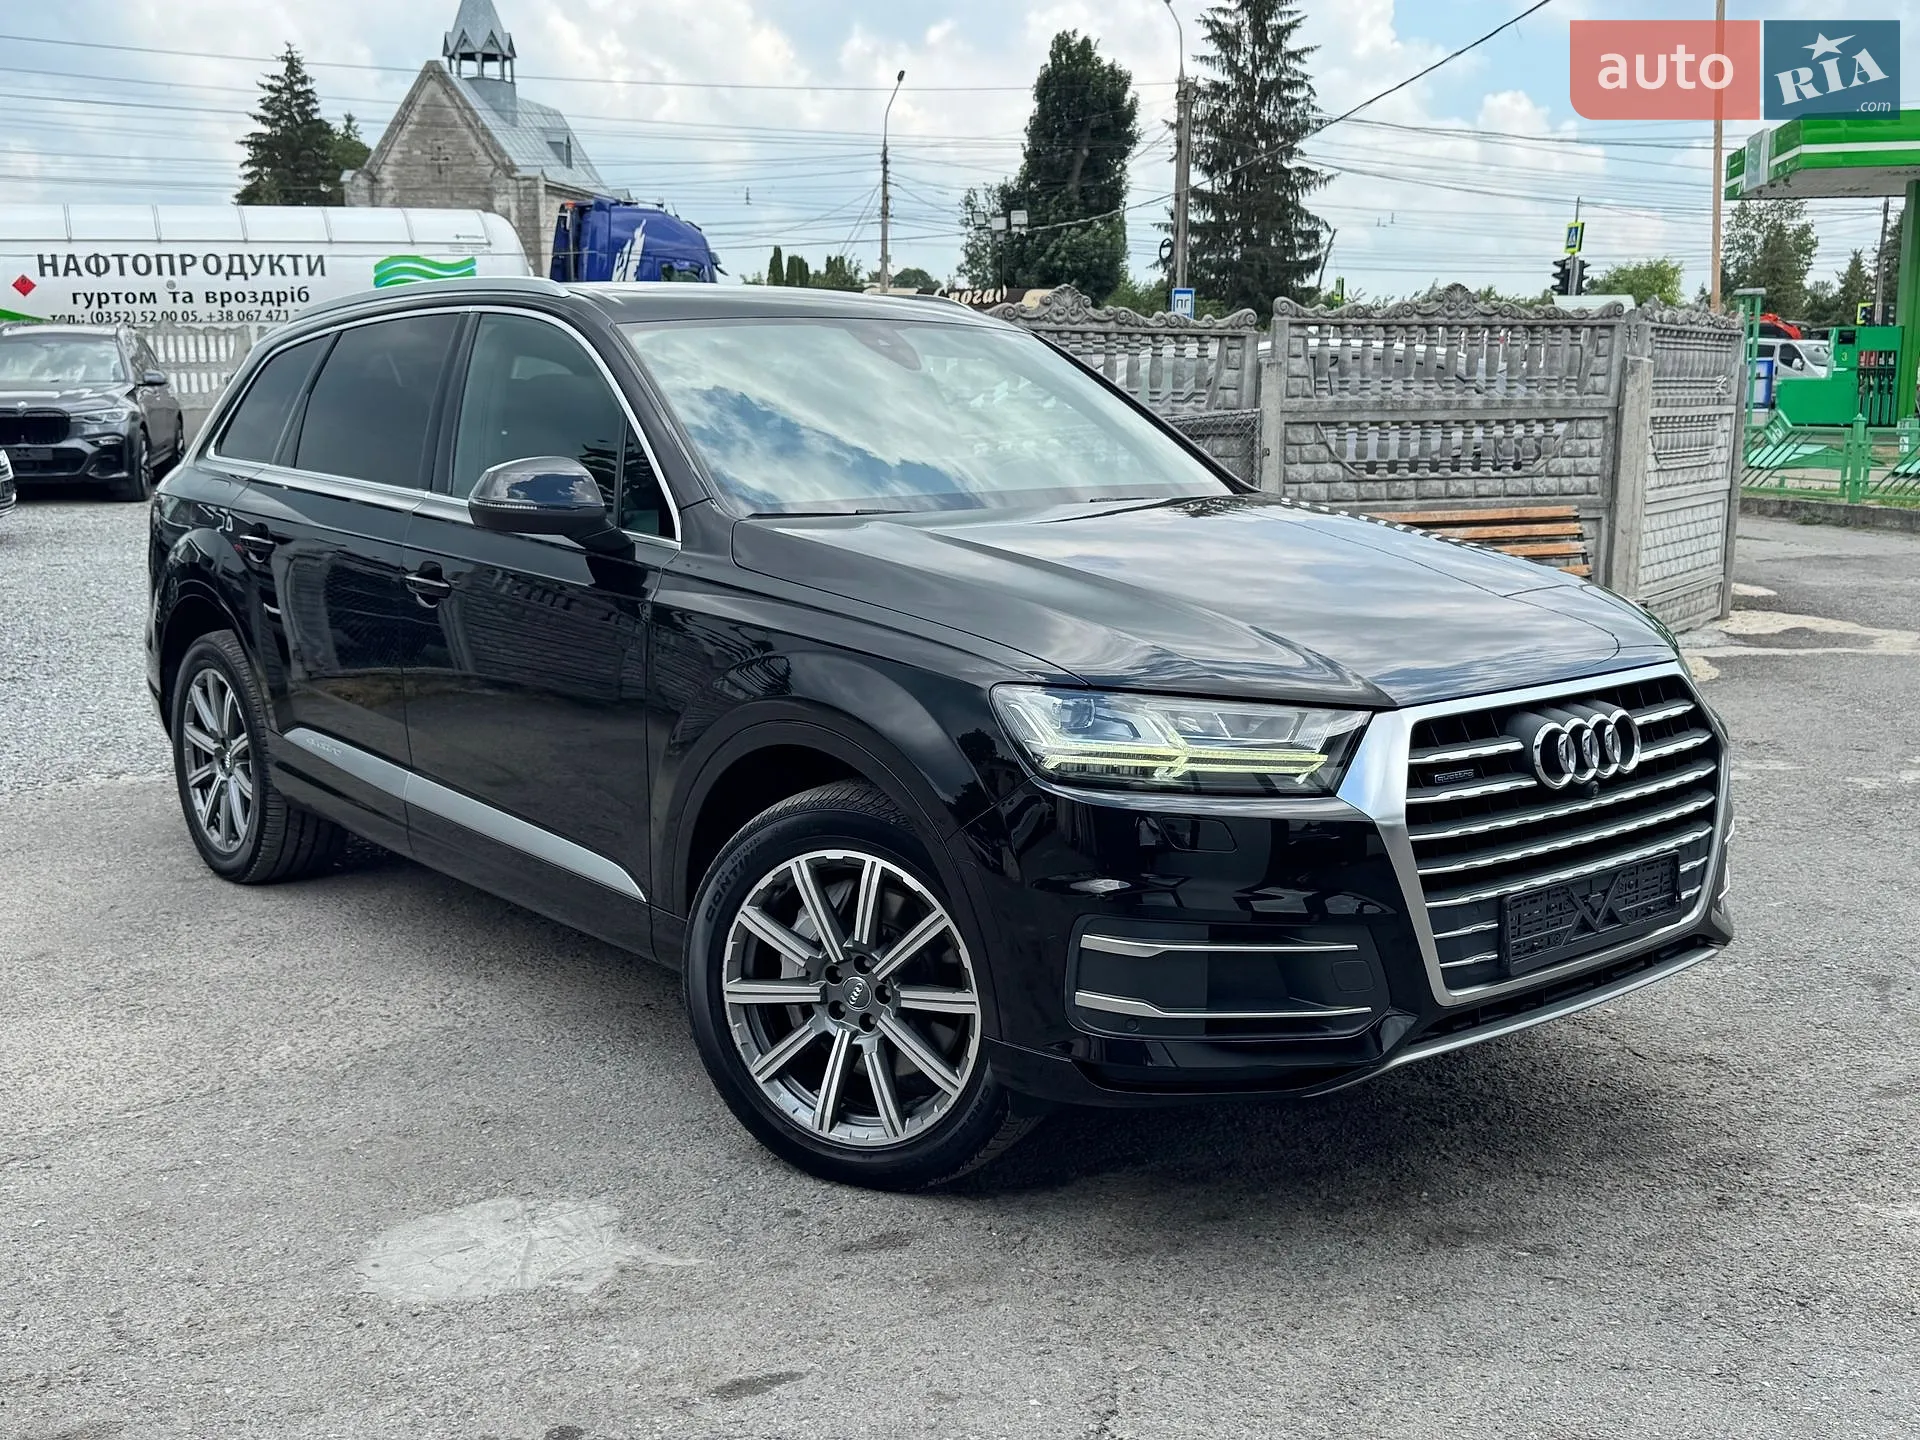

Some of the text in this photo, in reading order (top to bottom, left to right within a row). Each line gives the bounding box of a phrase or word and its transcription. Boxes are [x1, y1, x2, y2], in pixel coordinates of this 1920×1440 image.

[37, 253, 327, 280] НАФТОПРОДУКТИ
[72, 286, 310, 309] гуртом та вроздріб
[90, 310, 137, 324] (0352)
[141, 310, 157, 322] 52
[160, 310, 178, 322] 00
[182, 310, 203, 323] 05,
[207, 309, 234, 321] +38
[237, 309, 261, 321] 067
[265, 309, 289, 321] 471
[1841, 352, 1848, 361] 3
